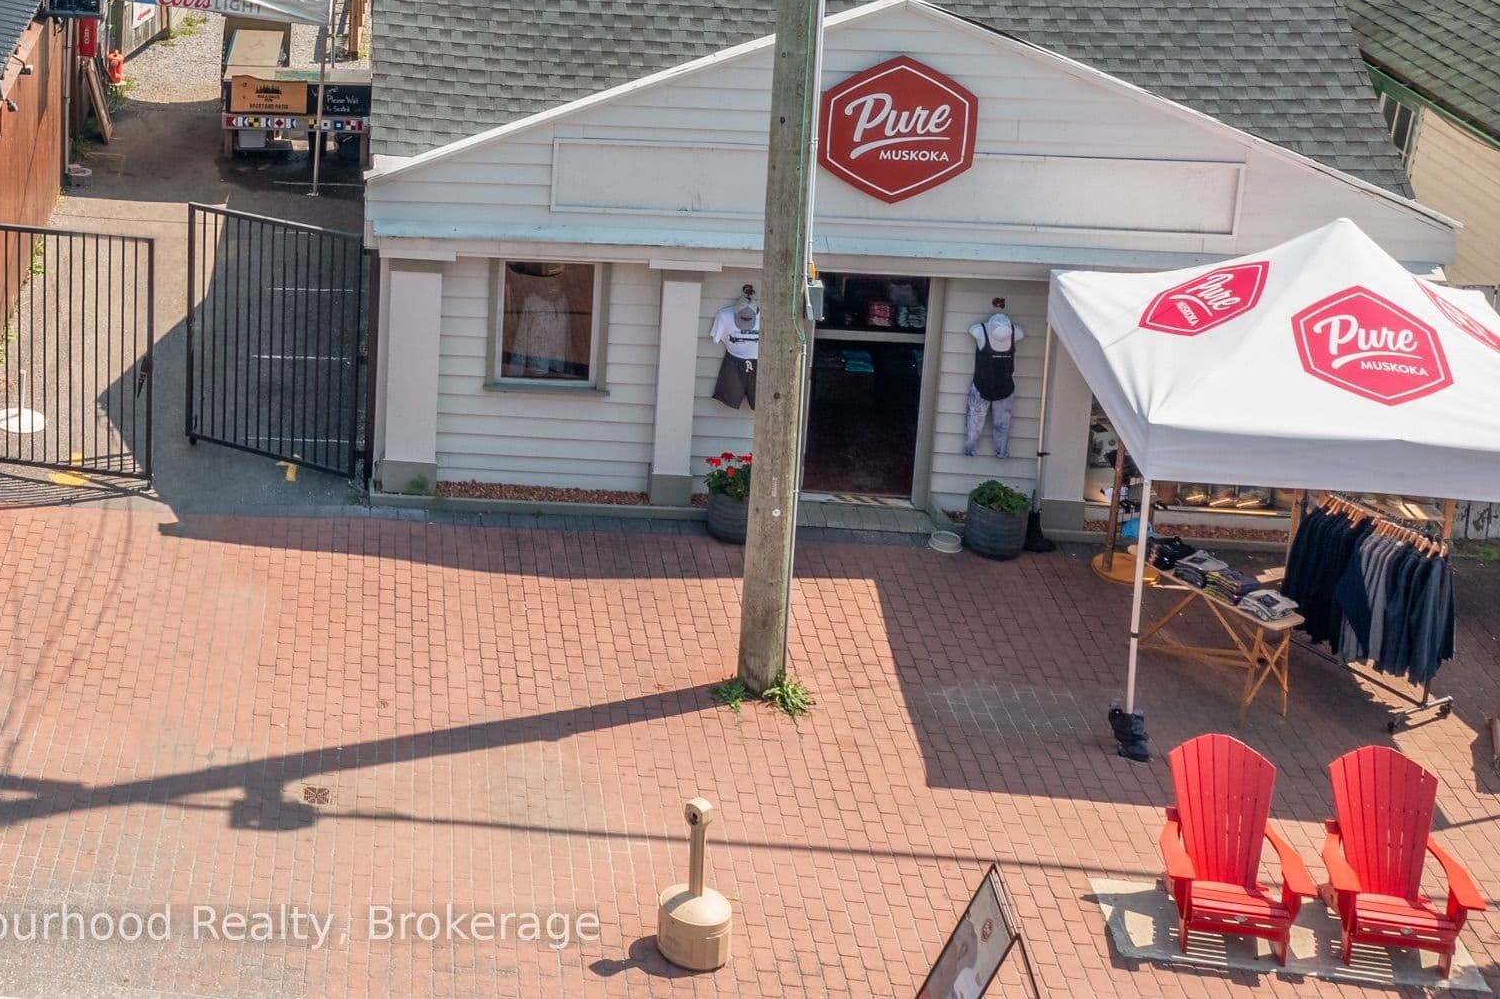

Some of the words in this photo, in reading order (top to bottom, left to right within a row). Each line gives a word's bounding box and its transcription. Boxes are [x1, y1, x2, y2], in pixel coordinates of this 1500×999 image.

[844, 92, 952, 143] Pure
[879, 150, 950, 162] MUSKOKA
[1185, 273, 1241, 311] Pure
[1313, 314, 1419, 355] Pure
[1360, 360, 1429, 377] MUSKOKA
